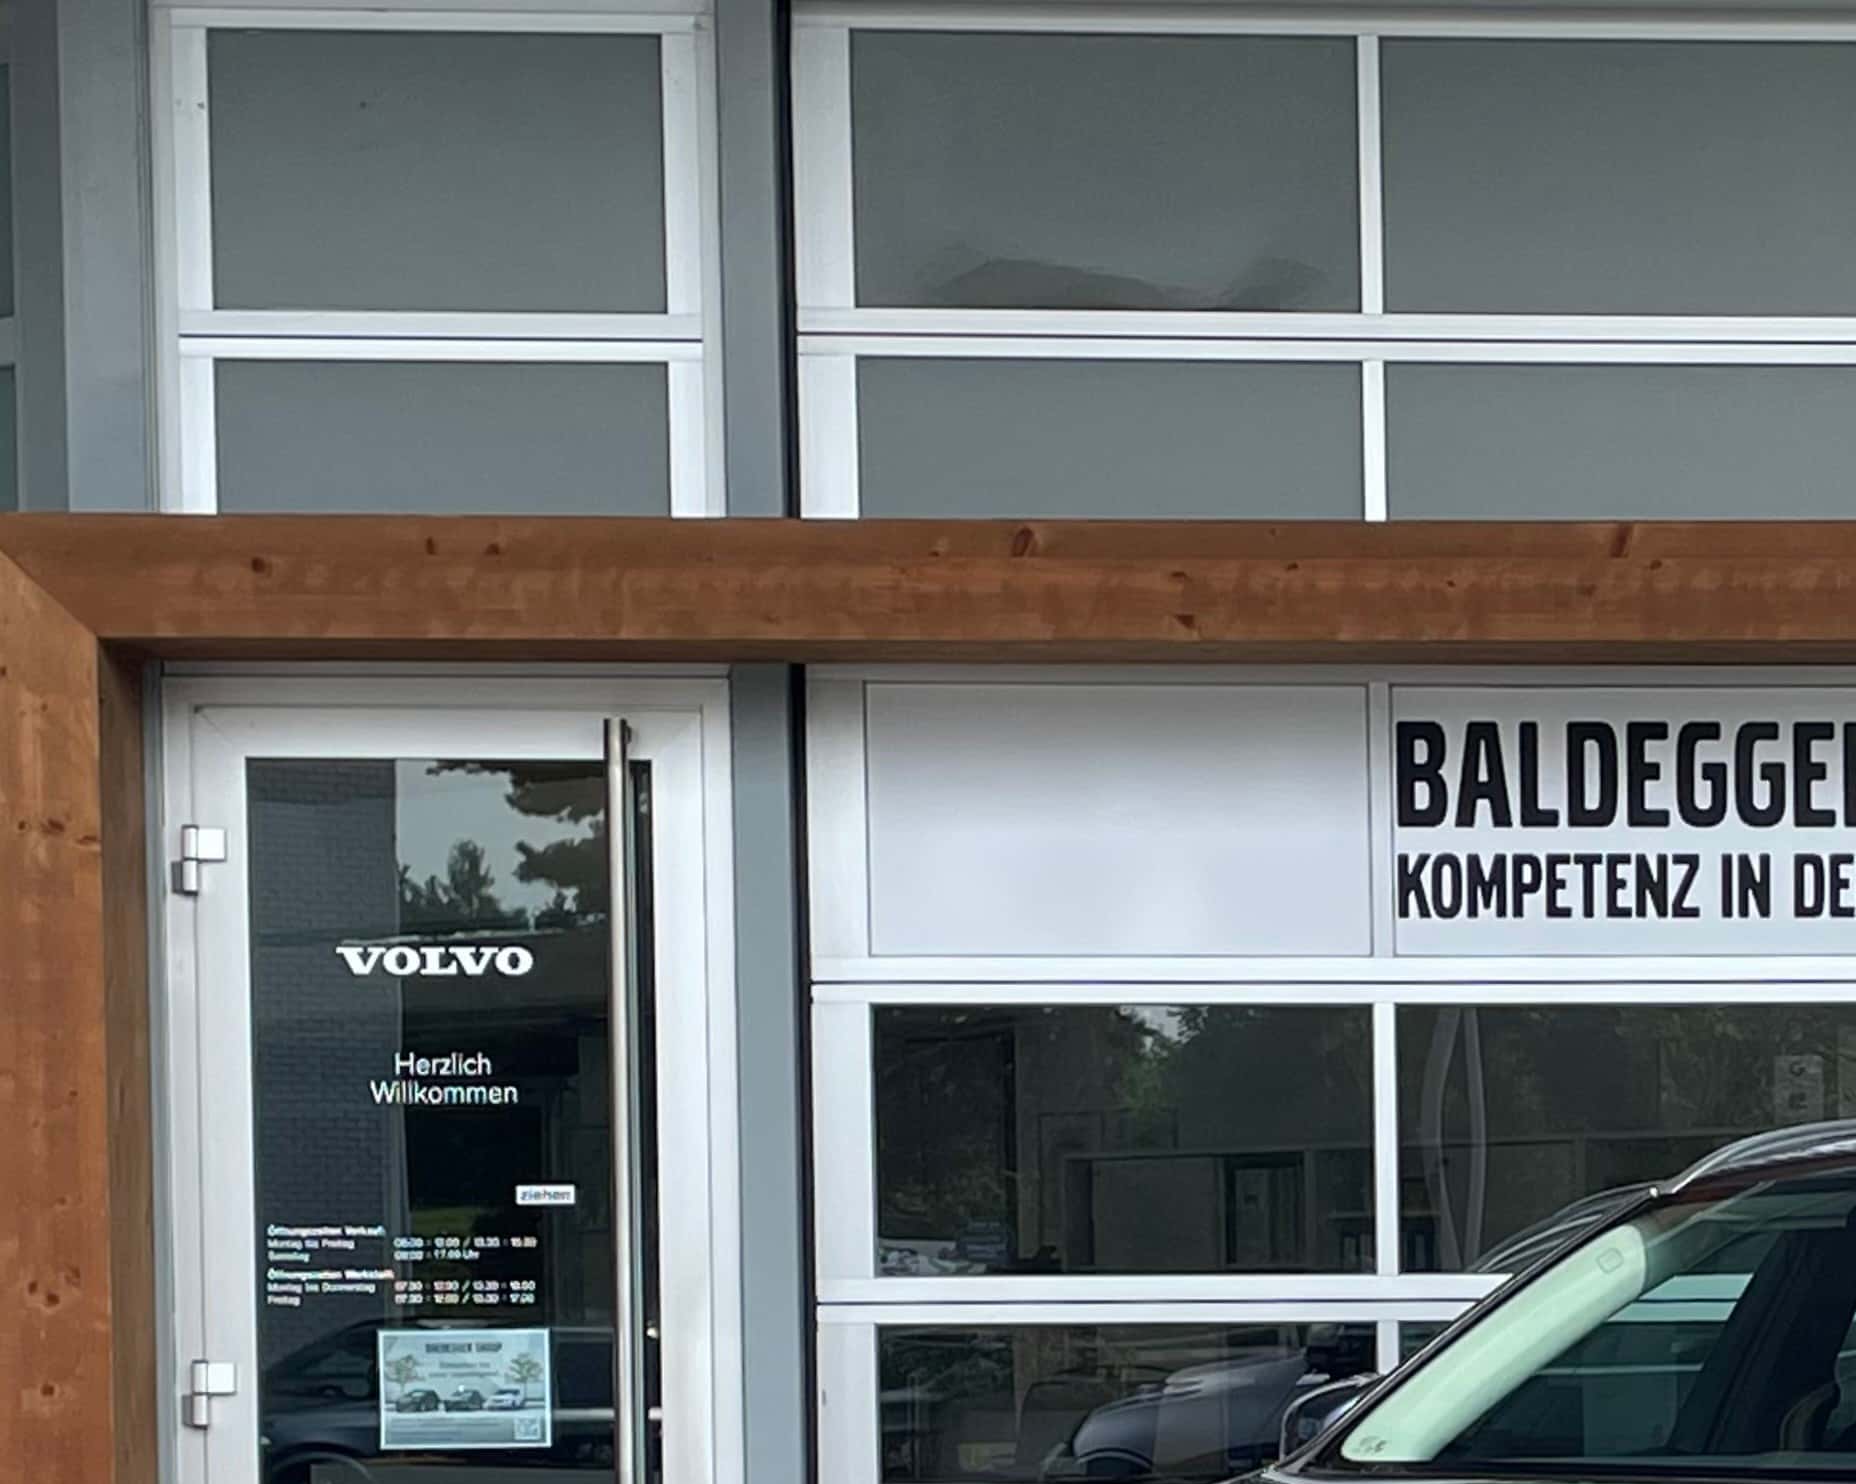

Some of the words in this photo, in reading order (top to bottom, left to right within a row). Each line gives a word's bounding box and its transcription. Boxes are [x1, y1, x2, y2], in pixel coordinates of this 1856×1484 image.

[1397, 853, 1701, 920] KOMPETENZ
[1721, 853, 1772, 919] IN
[335, 946, 535, 977] VOLVO
[394, 1051, 493, 1077] Herzlich
[369, 1079, 520, 1105] Willkommen
[519, 1189, 572, 1202] ziehen
